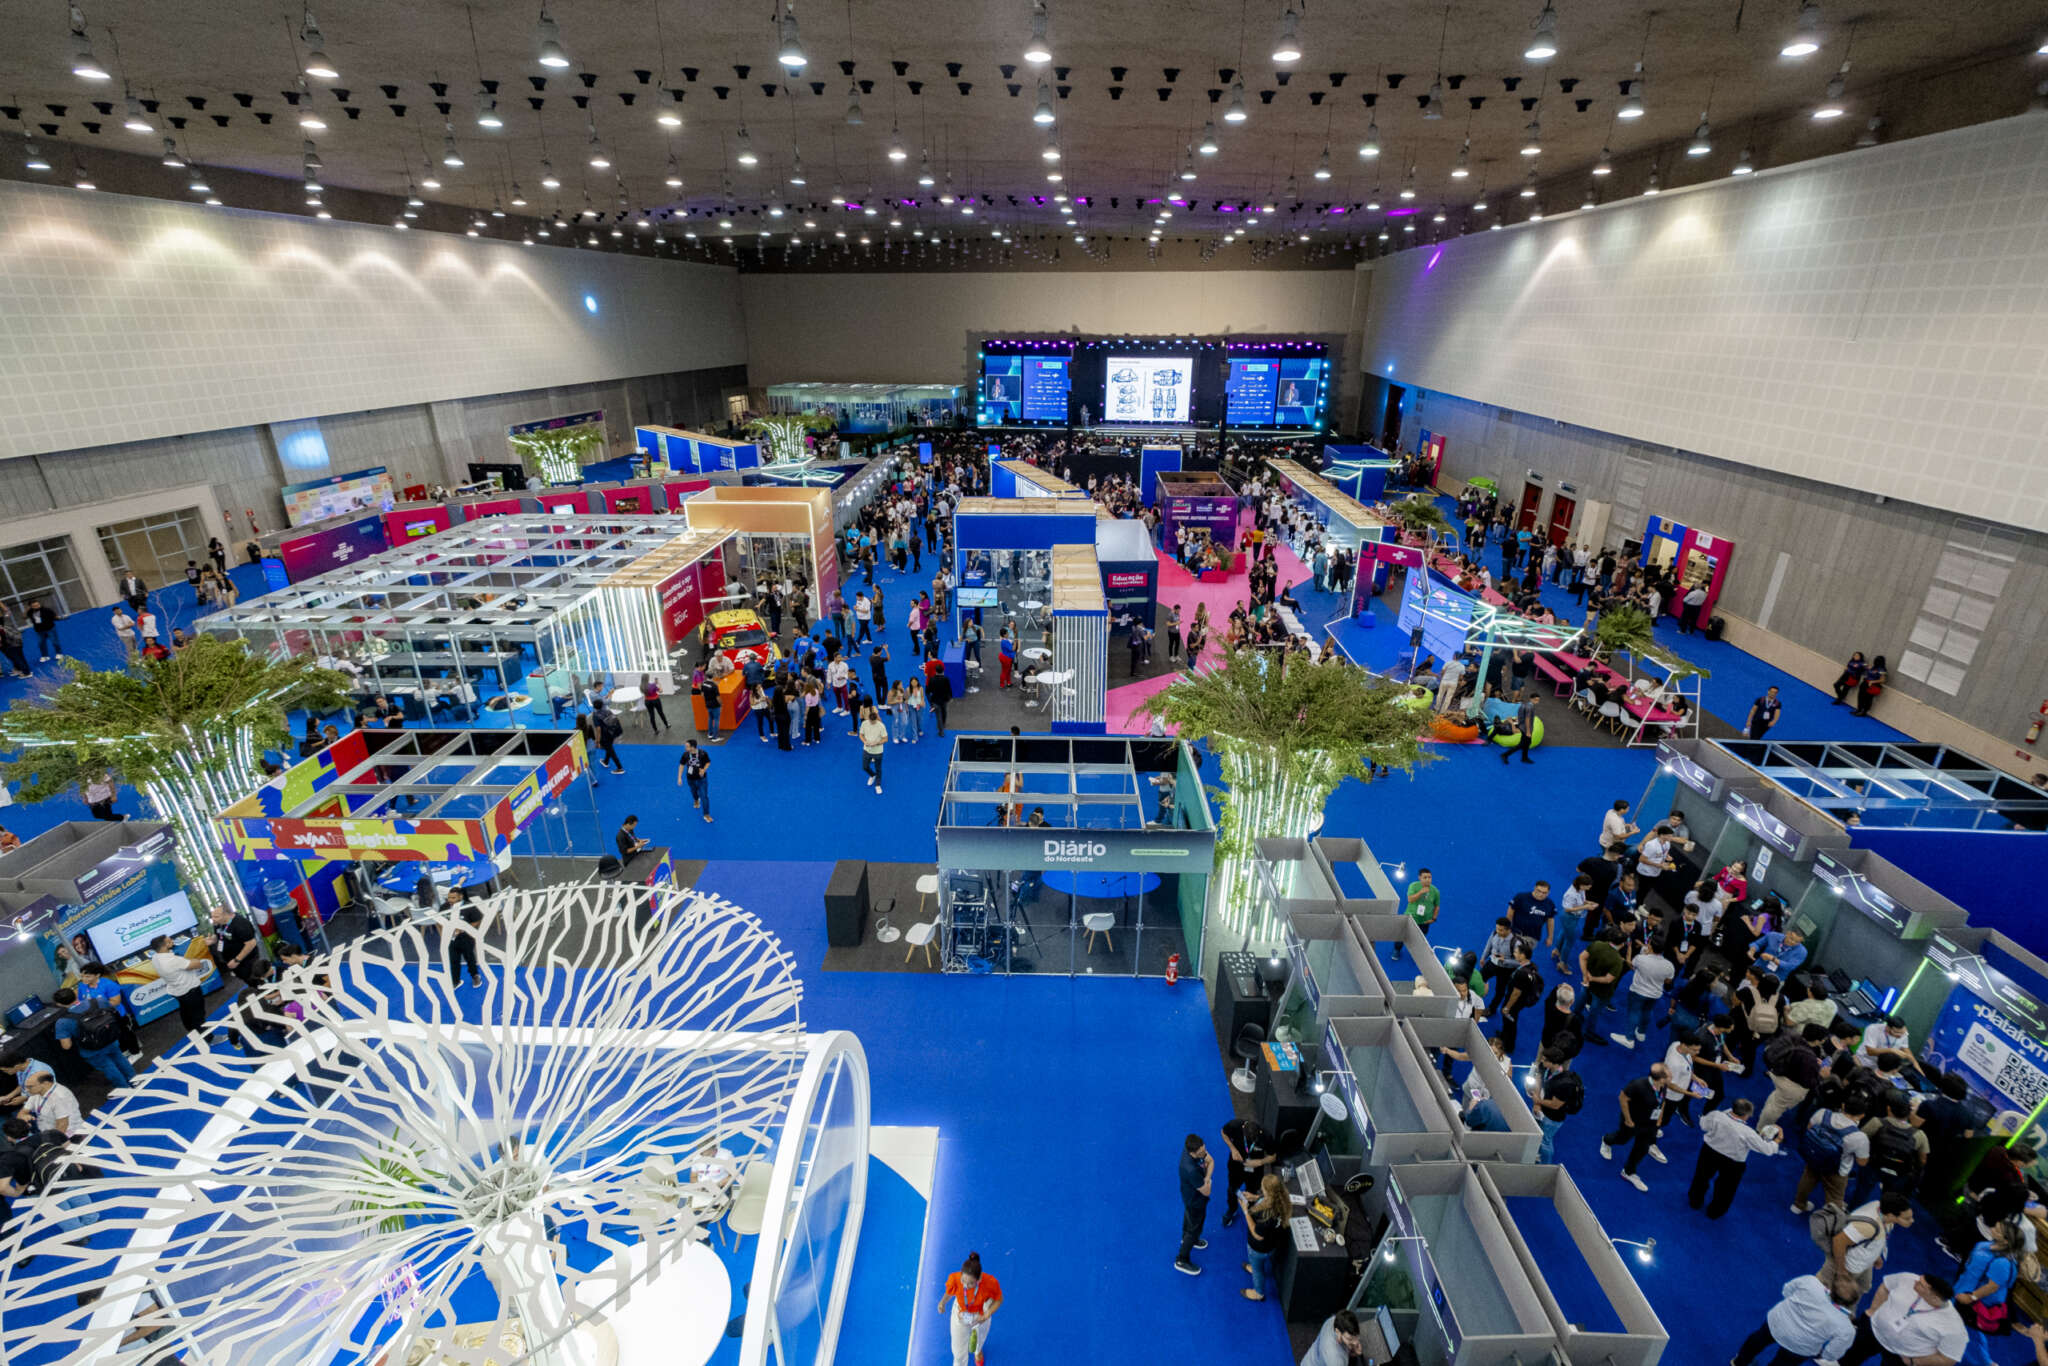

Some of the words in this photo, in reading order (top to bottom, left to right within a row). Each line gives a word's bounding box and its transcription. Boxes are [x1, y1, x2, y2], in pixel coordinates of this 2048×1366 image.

[1112, 574, 1144, 582] Educação
[513, 765, 570, 823] COWORKING
[1044, 840, 1107, 857] Diário
[96, 886, 122, 905] White
[121, 869, 147, 889] Label?
